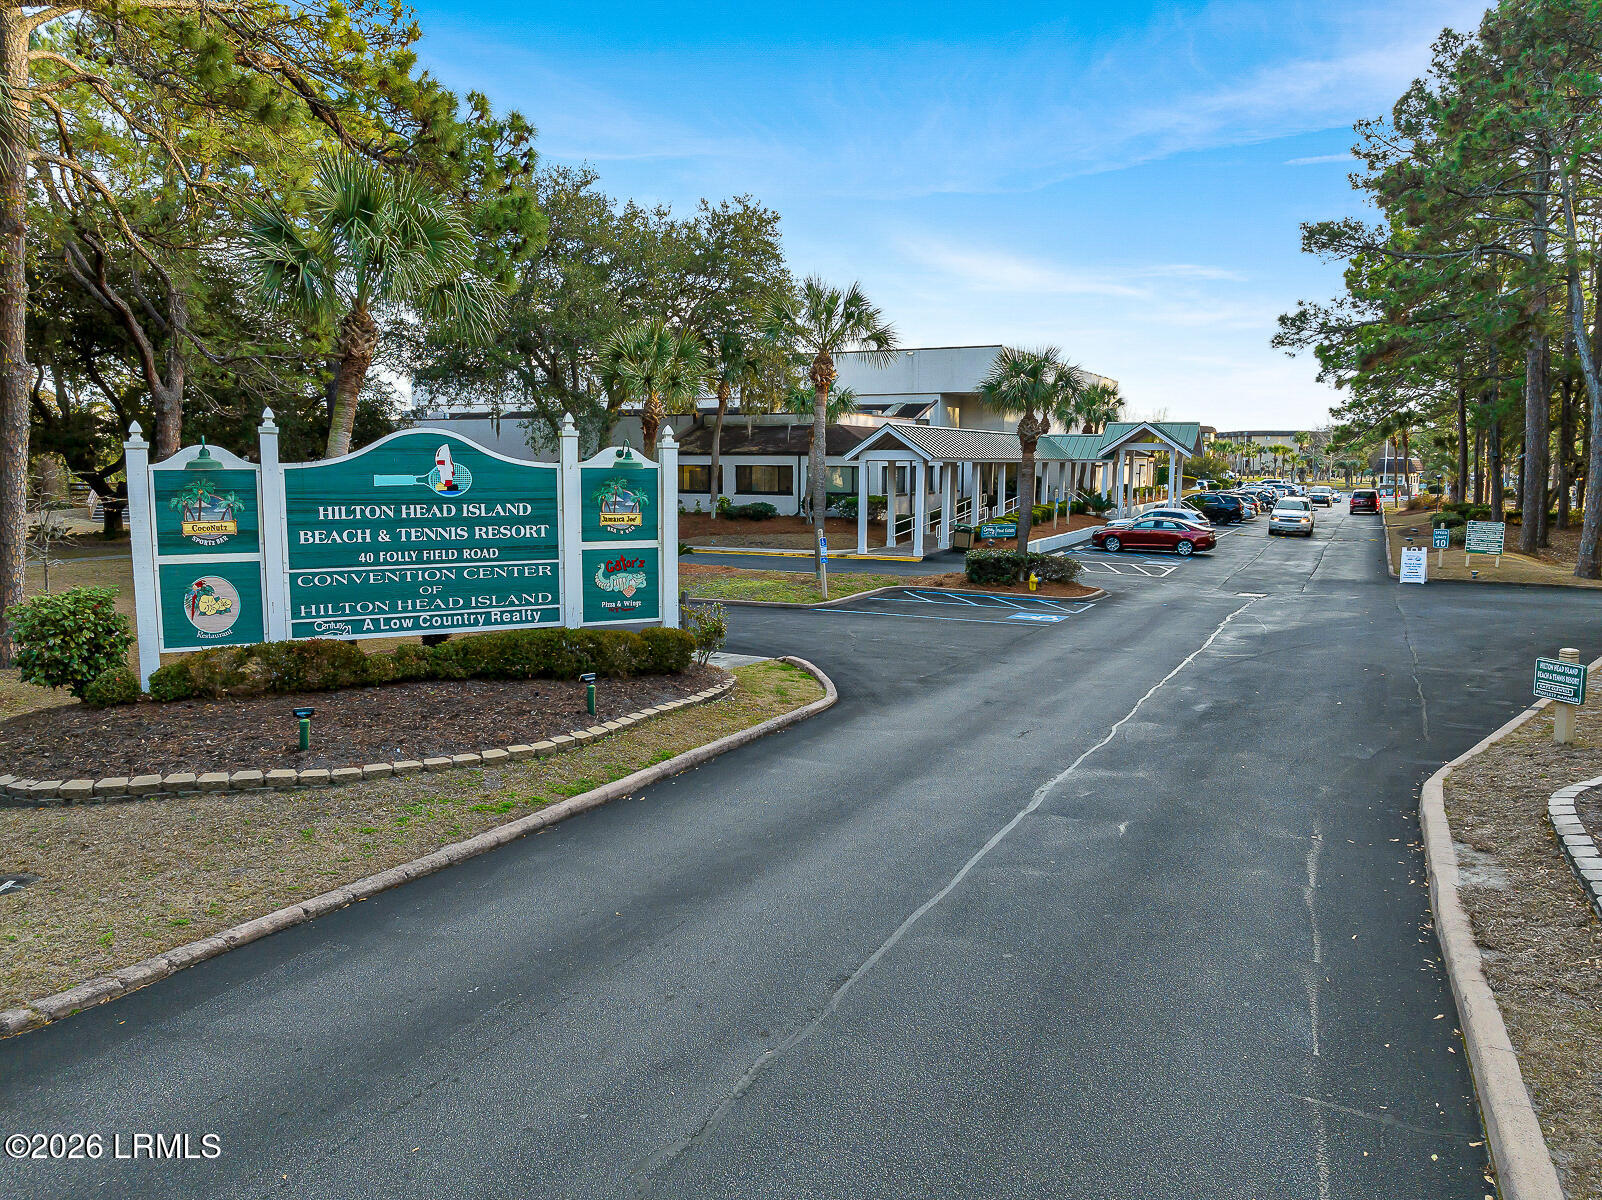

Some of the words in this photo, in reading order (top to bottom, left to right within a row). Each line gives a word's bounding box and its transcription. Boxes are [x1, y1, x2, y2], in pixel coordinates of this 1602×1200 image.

[318, 505, 395, 520] HILTON
[401, 504, 456, 518] HEAD
[462, 503, 532, 517] ISLAND
[216, 535, 229, 545] BAR
[299, 528, 372, 544] BEACH
[378, 530, 392, 542] &
[396, 527, 468, 542] TENNIS
[474, 524, 549, 539] RESORT
[358, 552, 374, 563] 40
[379, 550, 418, 562] FOLLY
[423, 549, 458, 561] FIELD
[463, 548, 499, 559] ROAD
[297, 569, 456, 588] CONVENTION
[463, 565, 552, 580] CENTER
[419, 585, 443, 595] OF
[300, 600, 390, 617] HILTON
[397, 597, 464, 611] HEAD
[470, 592, 552, 608] ISLAND
[314, 620, 344, 632] Century
[342, 624, 352, 636] 21
[362, 618, 374, 631] A
[380, 617, 413, 630] Low
[419, 612, 486, 630] Country
[491, 609, 541, 625] Realty
[196, 629, 233, 639] Restaurant
